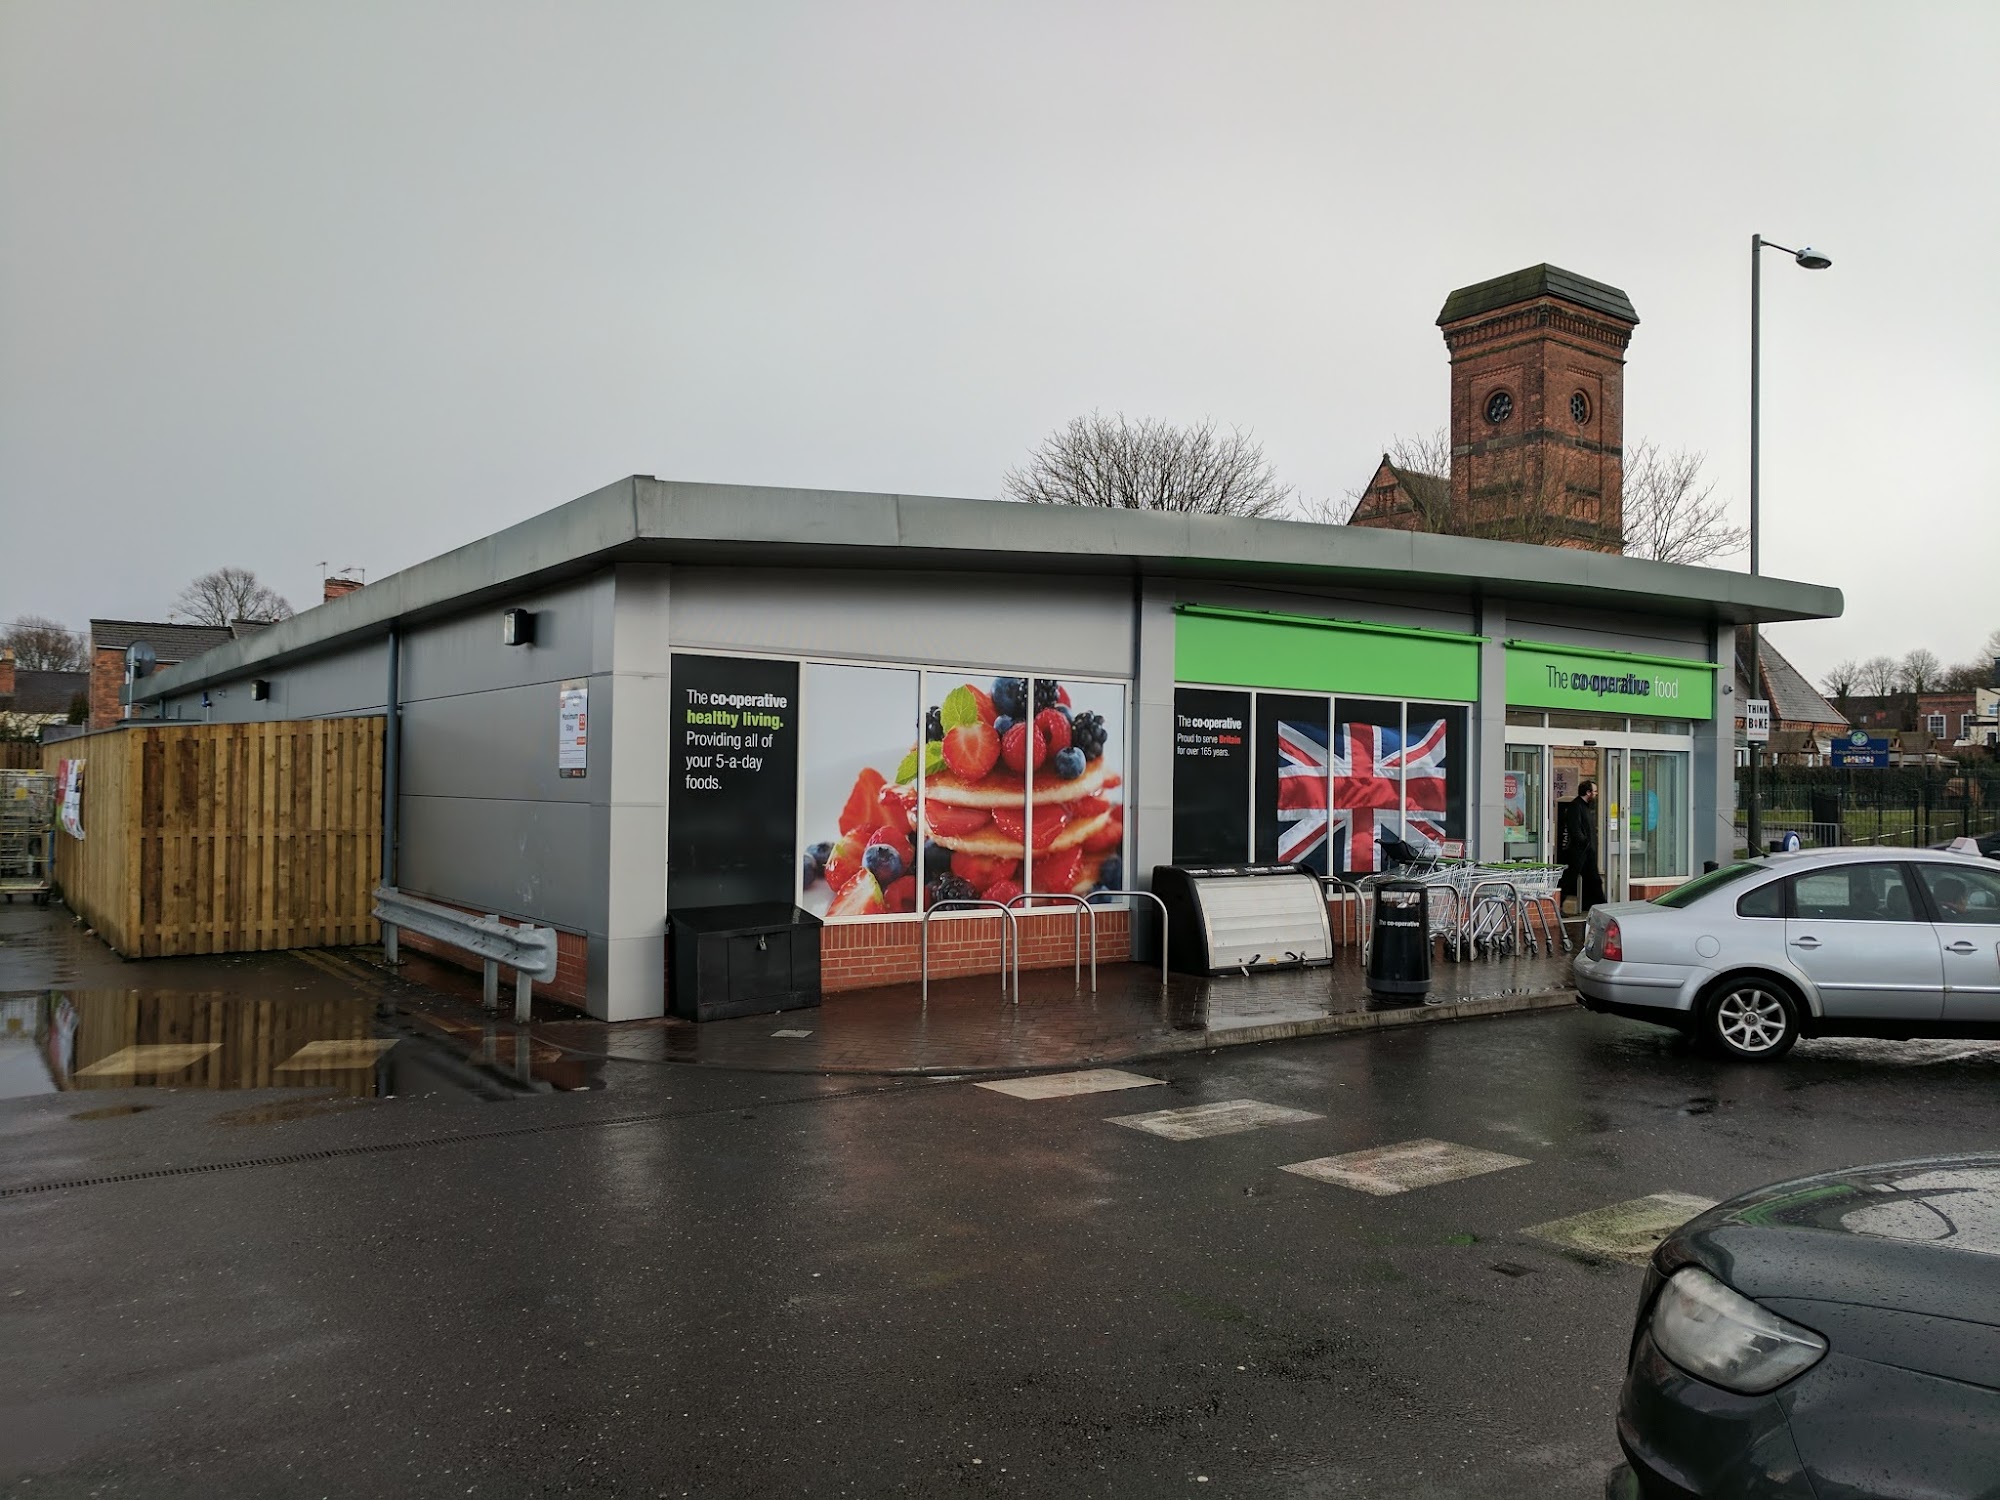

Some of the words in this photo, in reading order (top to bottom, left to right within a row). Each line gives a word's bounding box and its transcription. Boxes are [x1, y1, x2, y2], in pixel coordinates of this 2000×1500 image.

[1546, 665, 1568, 689] The
[1654, 676, 1679, 699] food
[686, 689, 708, 705] The
[1747, 704, 1768, 714] THINK
[686, 709, 739, 729] healthy
[742, 711, 784, 730] living.
[1177, 715, 1191, 727] The
[686, 731, 741, 750] Providing
[745, 733, 758, 748] all
[761, 733, 774, 748] of
[1177, 733, 1195, 743] Proud
[1196, 734, 1202, 743] to
[1202, 736, 1218, 744] serve
[1219, 735, 1241, 745] Britain
[1200, 747, 1212, 756] 165
[1212, 749, 1230, 758] years.
[686, 755, 713, 771] your
[715, 753, 763, 772] 5-a-day
[685, 774, 722, 790] foods.
[1554, 782, 1567, 790] PART
